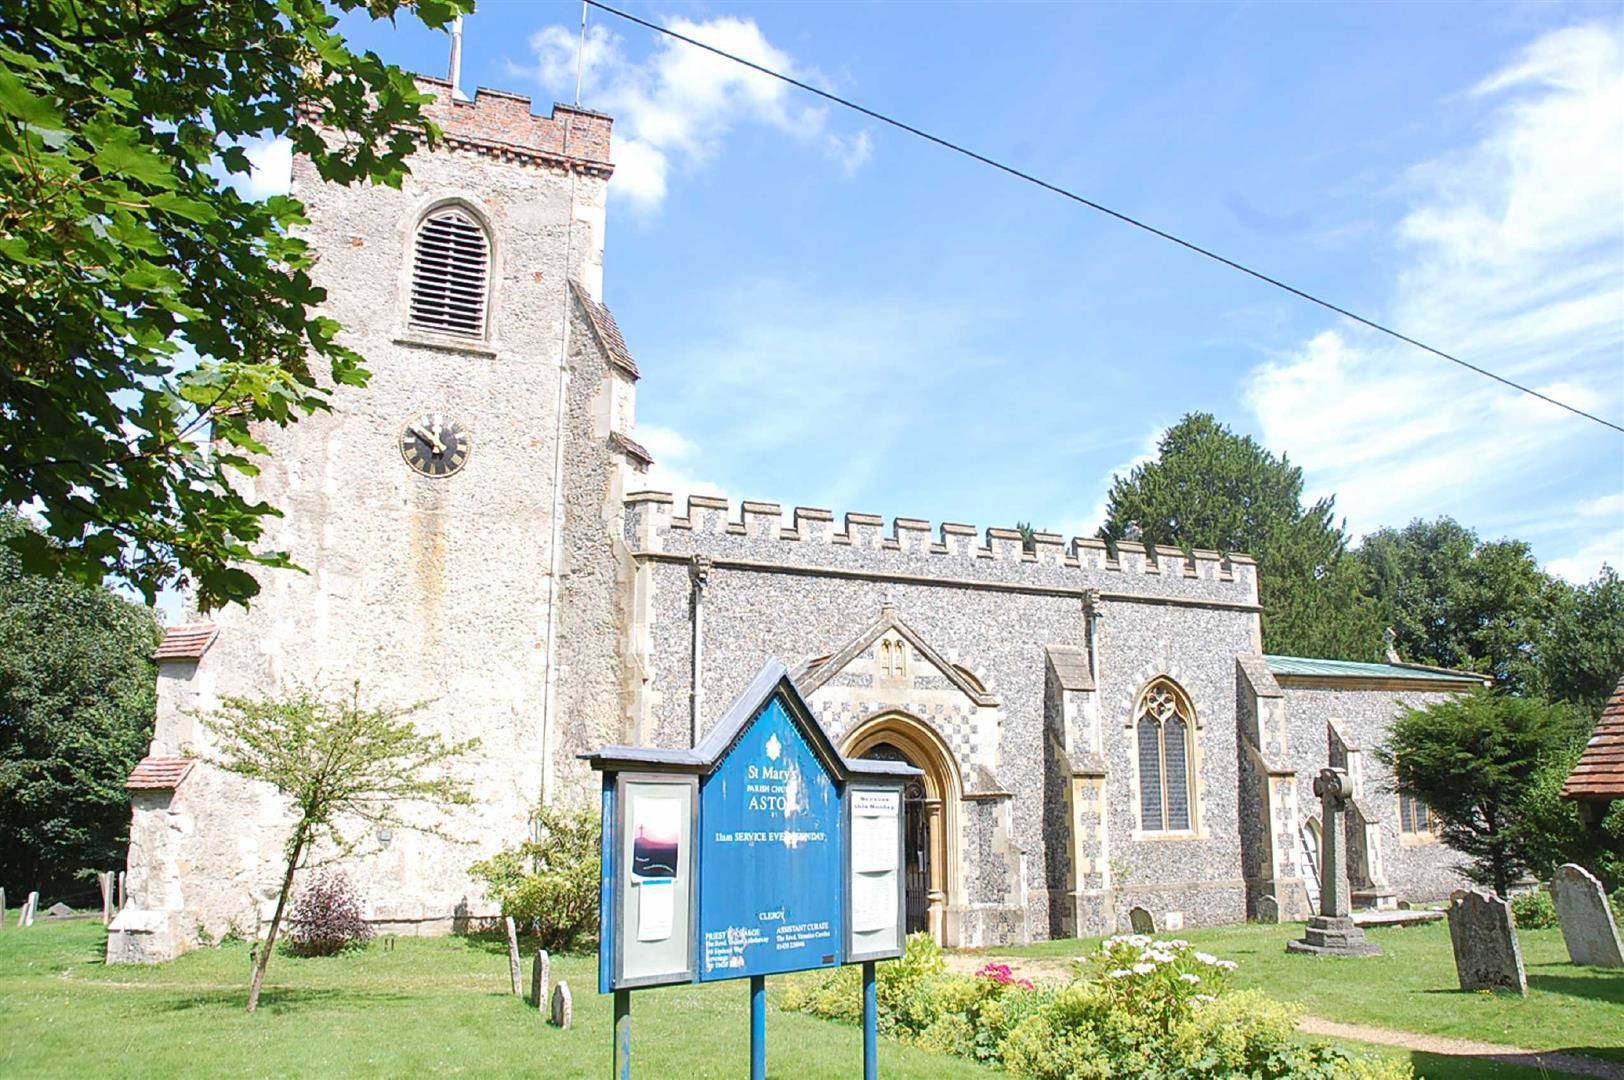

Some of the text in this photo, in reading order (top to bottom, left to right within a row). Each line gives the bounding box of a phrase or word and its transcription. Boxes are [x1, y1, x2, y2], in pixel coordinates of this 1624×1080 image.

[748, 765, 759, 779] St
[746, 784, 770, 793] PARISH
[748, 796, 798, 811] ASTO
[734, 832, 767, 842] SERVICE
[759, 912, 784, 921] CLERGY
[776, 922, 829, 934] ASSISTANT CURATE
